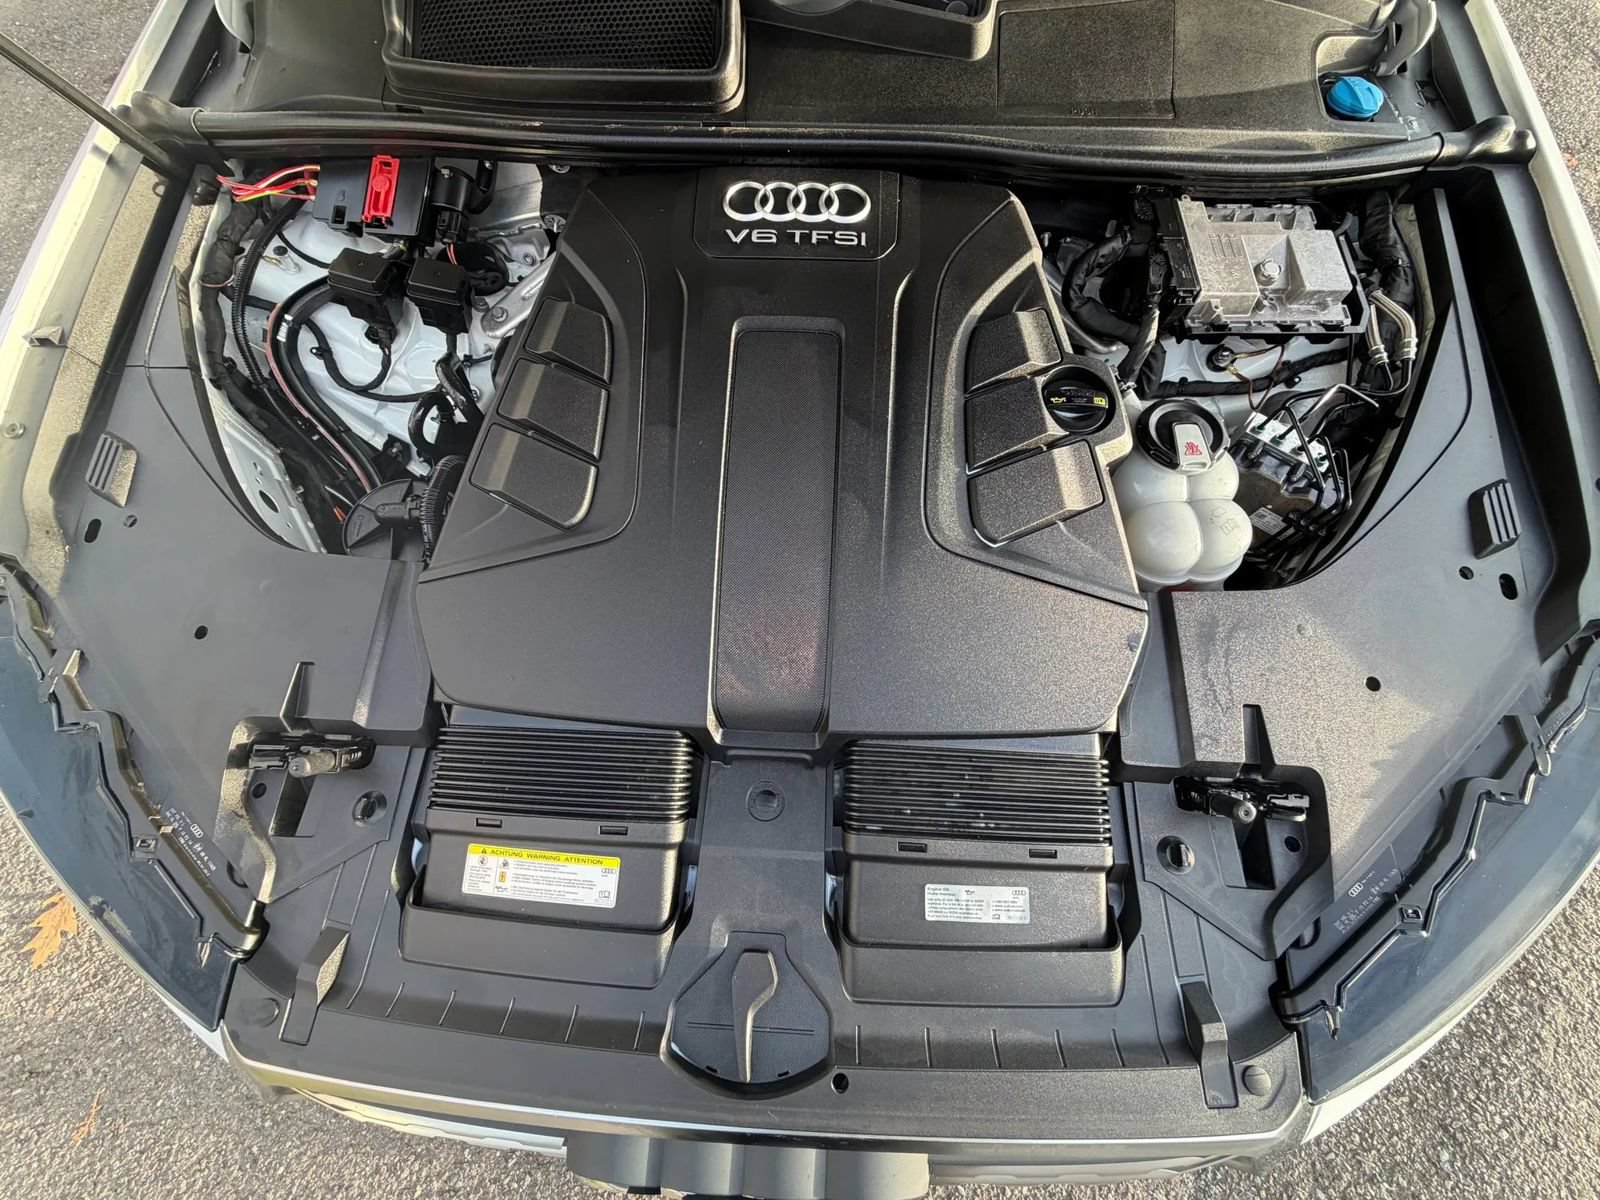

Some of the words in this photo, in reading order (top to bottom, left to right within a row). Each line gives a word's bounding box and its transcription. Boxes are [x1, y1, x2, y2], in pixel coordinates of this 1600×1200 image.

[725, 229, 777, 244] V6
[786, 230, 866, 247] TFSI
[490, 849, 523, 858] ACHTUNG
[526, 853, 561, 862] WARNING
[564, 856, 604, 865] ATTENTION
